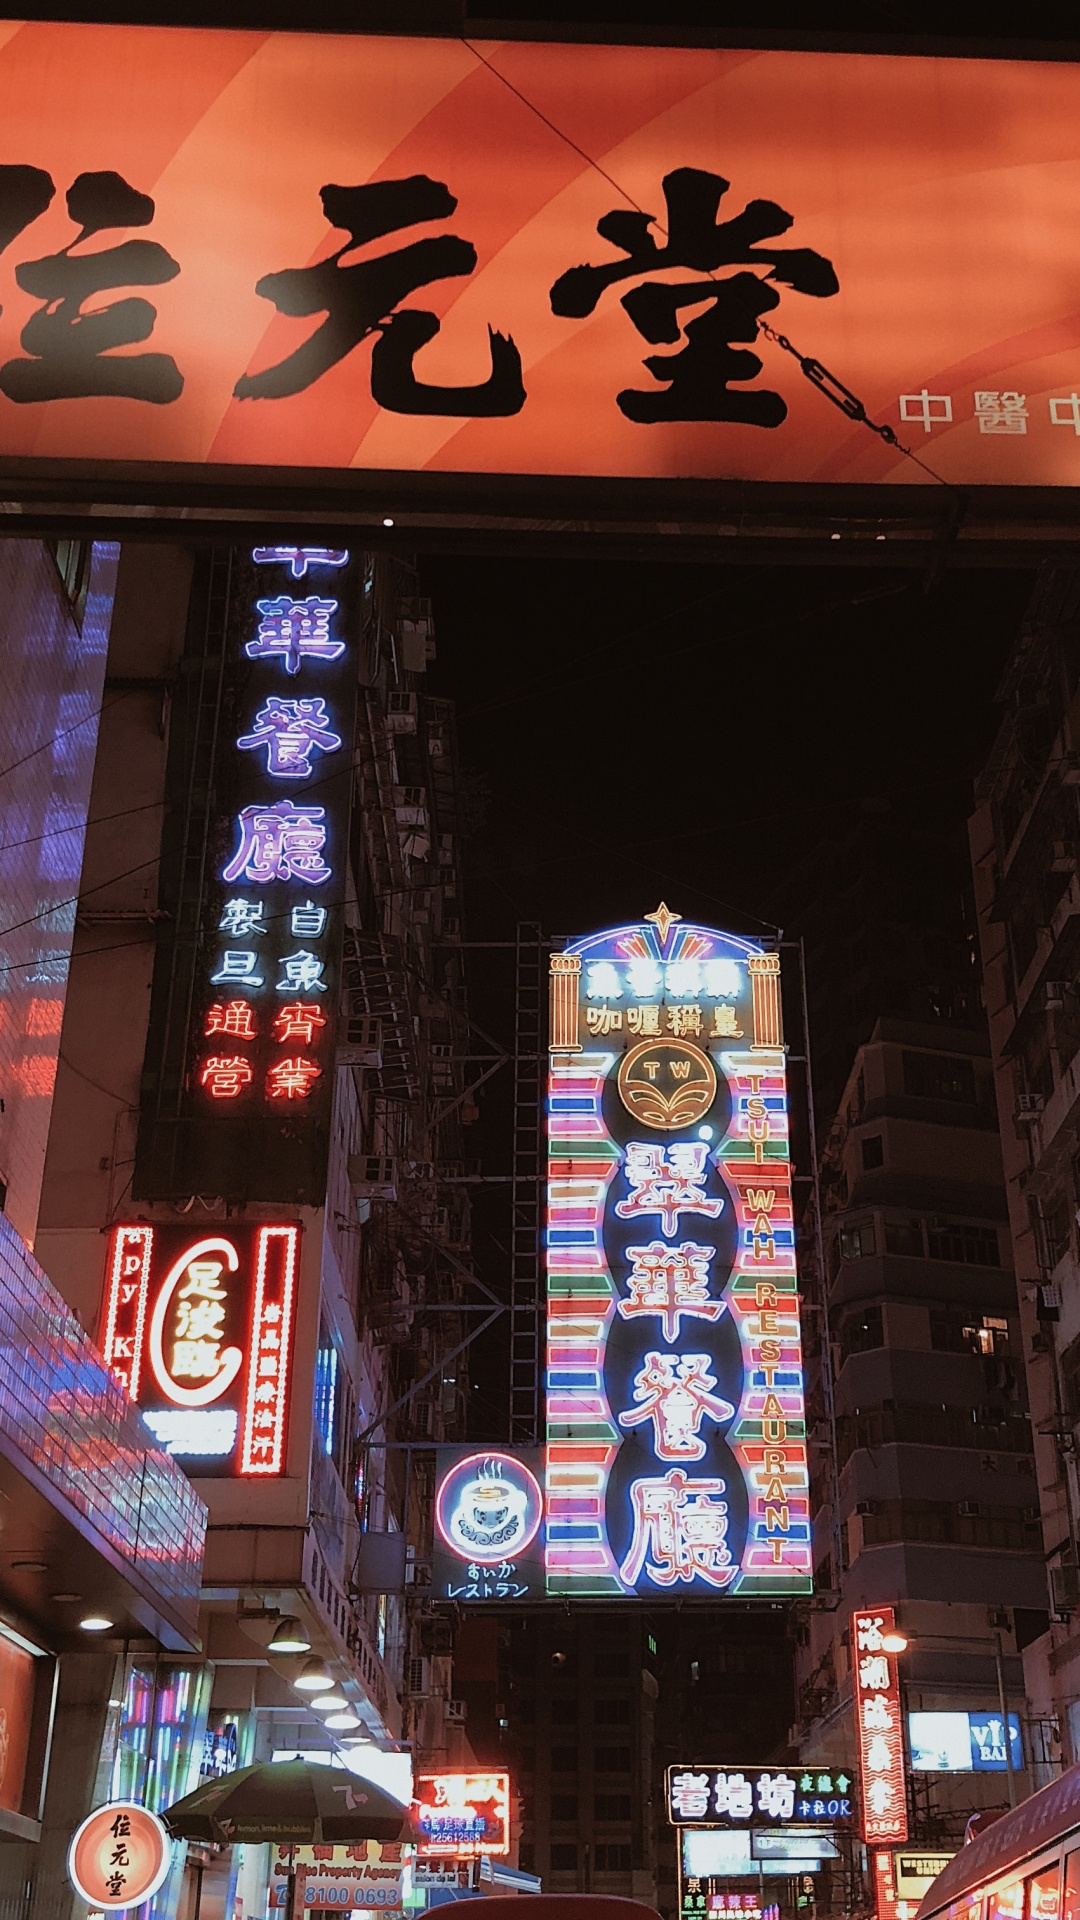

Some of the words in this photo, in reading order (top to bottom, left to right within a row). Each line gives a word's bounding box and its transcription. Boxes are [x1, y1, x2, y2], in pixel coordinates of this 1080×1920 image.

[0, 165, 840, 428] 位元堂
[746, 1074, 769, 1165] TSUI
[746, 1188, 775, 1261] WAH
[614, 1141, 739, 1589] 翠華餐廳
[754, 1282, 791, 1564] RESTAURANT
[447, 1582, 530, 1598] レストラン
[105, 1814, 131, 1897] 位元堂
[305, 1887, 349, 1904] 8100
[354, 1887, 399, 1905] 0693
[319, 1864, 363, 1880] Property
[364, 1865, 402, 1881] Agency
